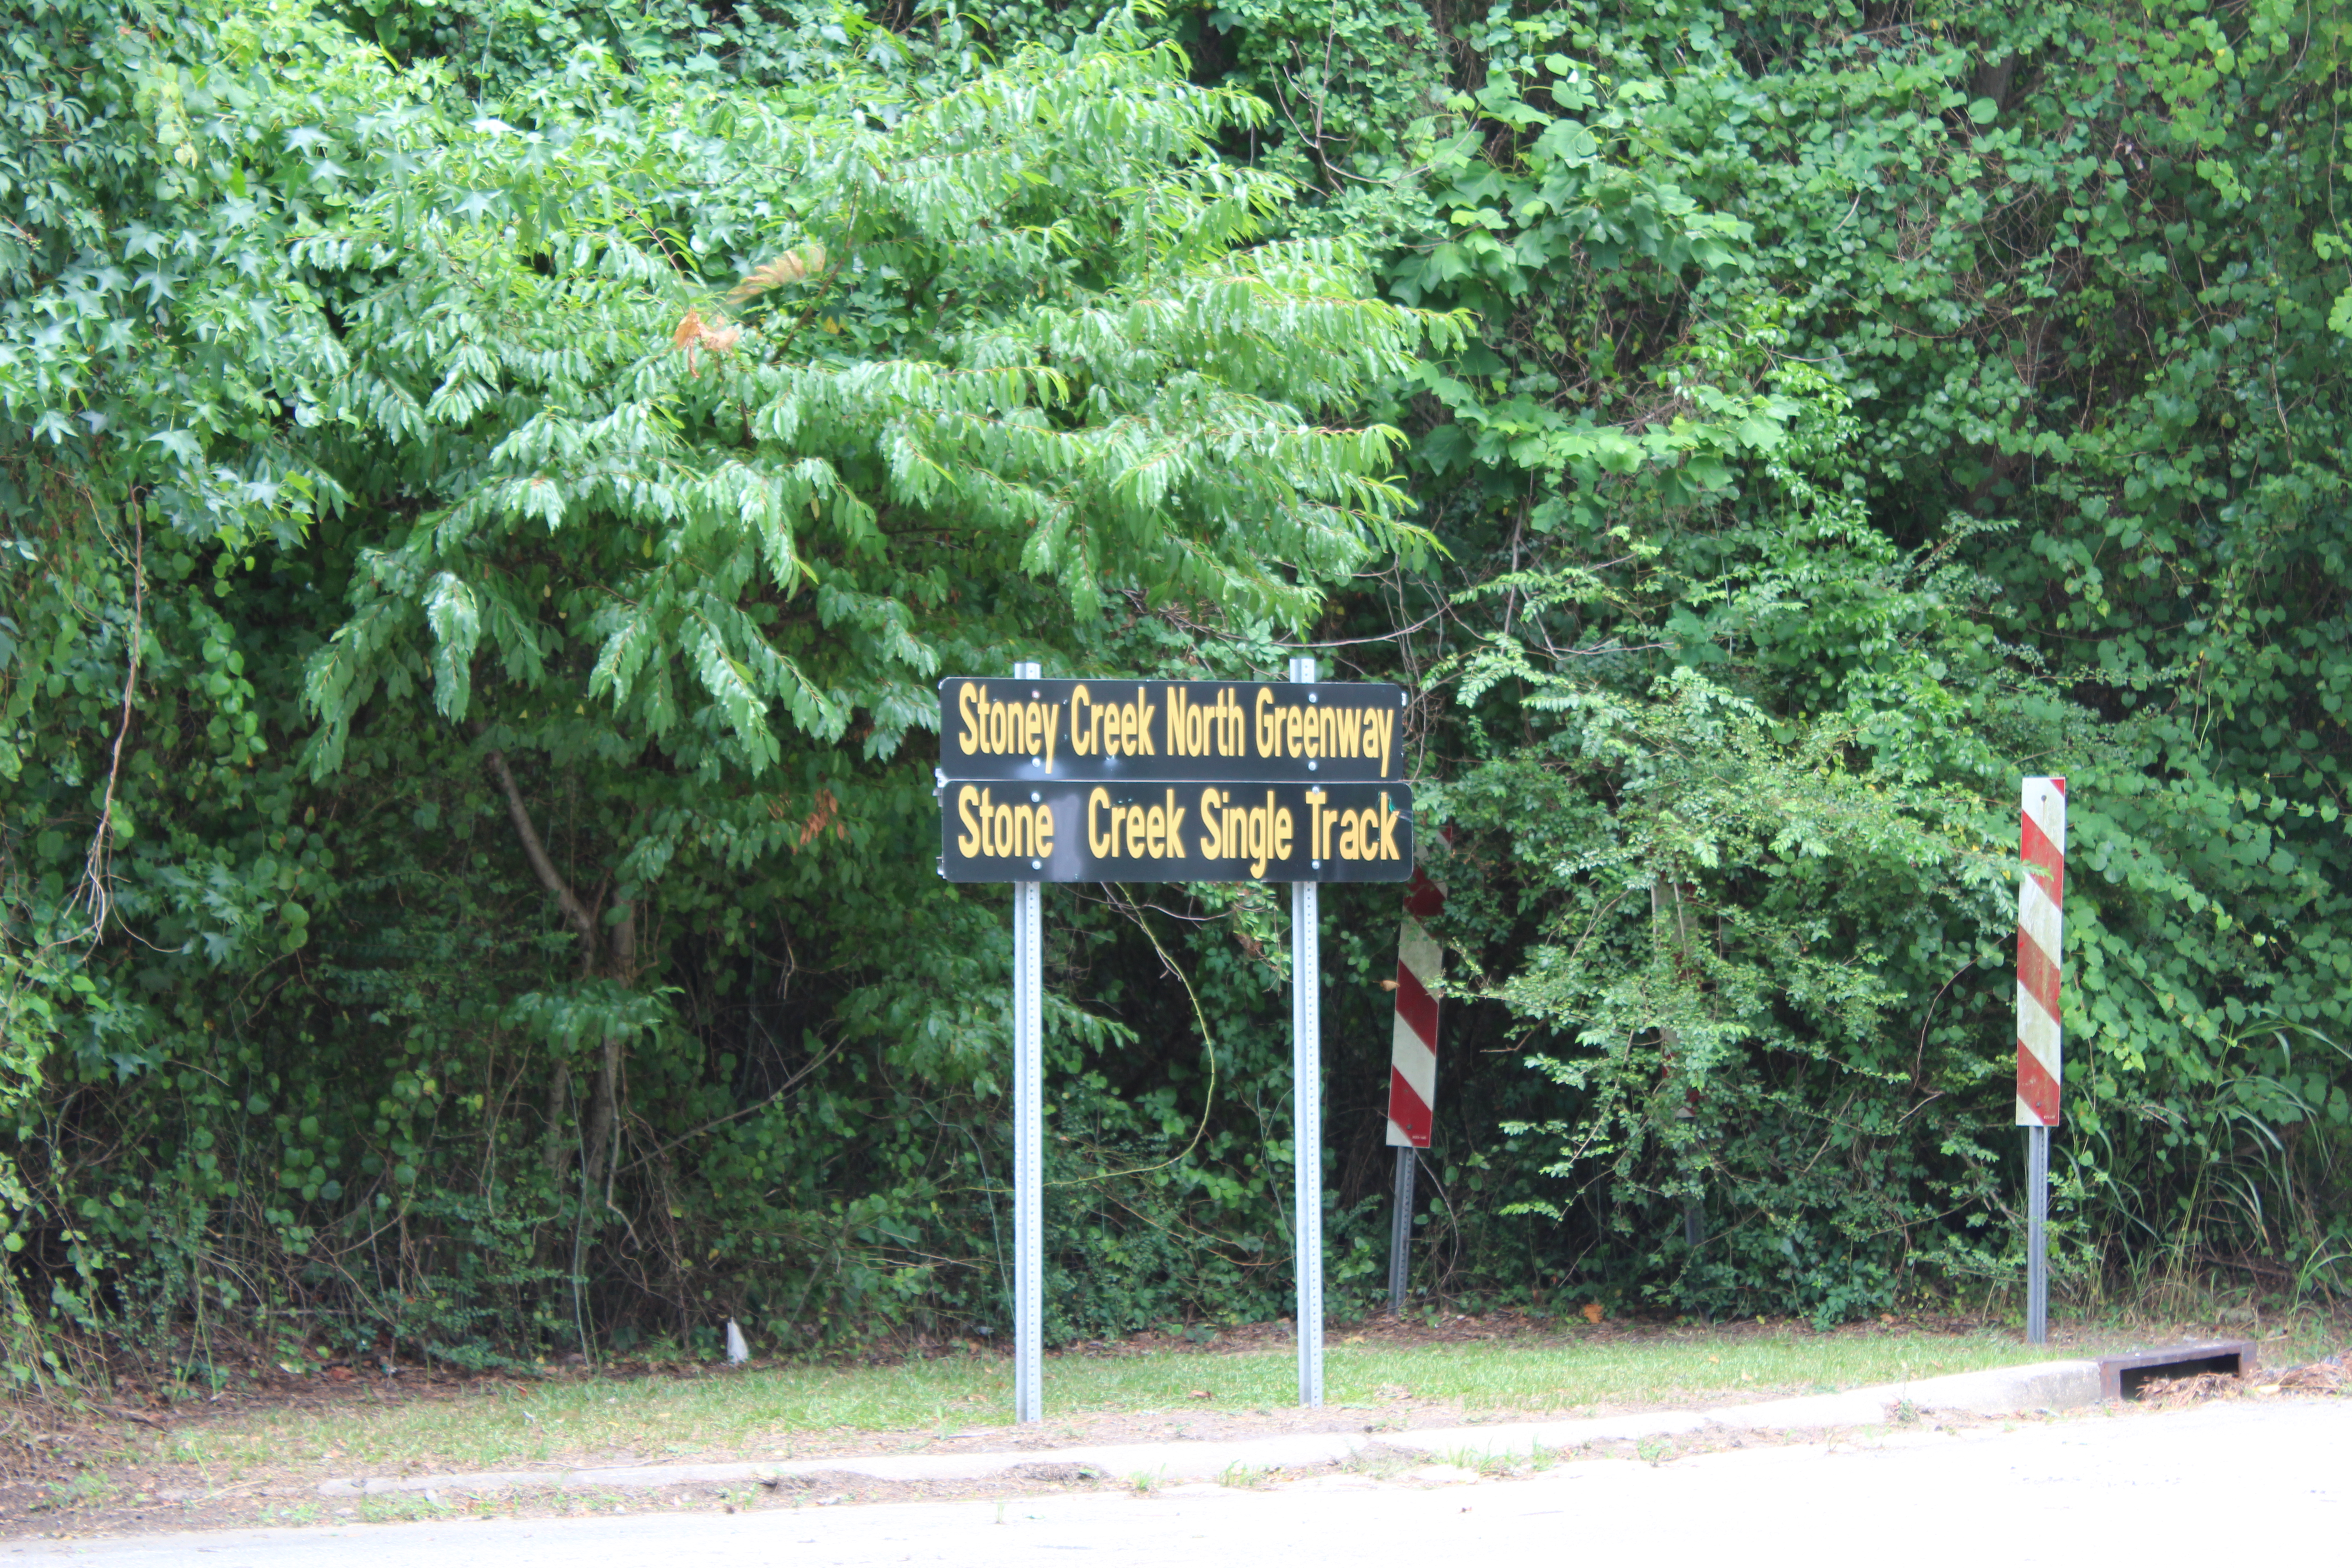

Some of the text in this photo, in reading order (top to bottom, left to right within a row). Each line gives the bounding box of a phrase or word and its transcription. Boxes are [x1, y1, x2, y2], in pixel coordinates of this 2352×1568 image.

[958, 682, 1394, 778] Stoney Creek North Greenway
[958, 785, 1401, 879] Stone Creek Single Track
